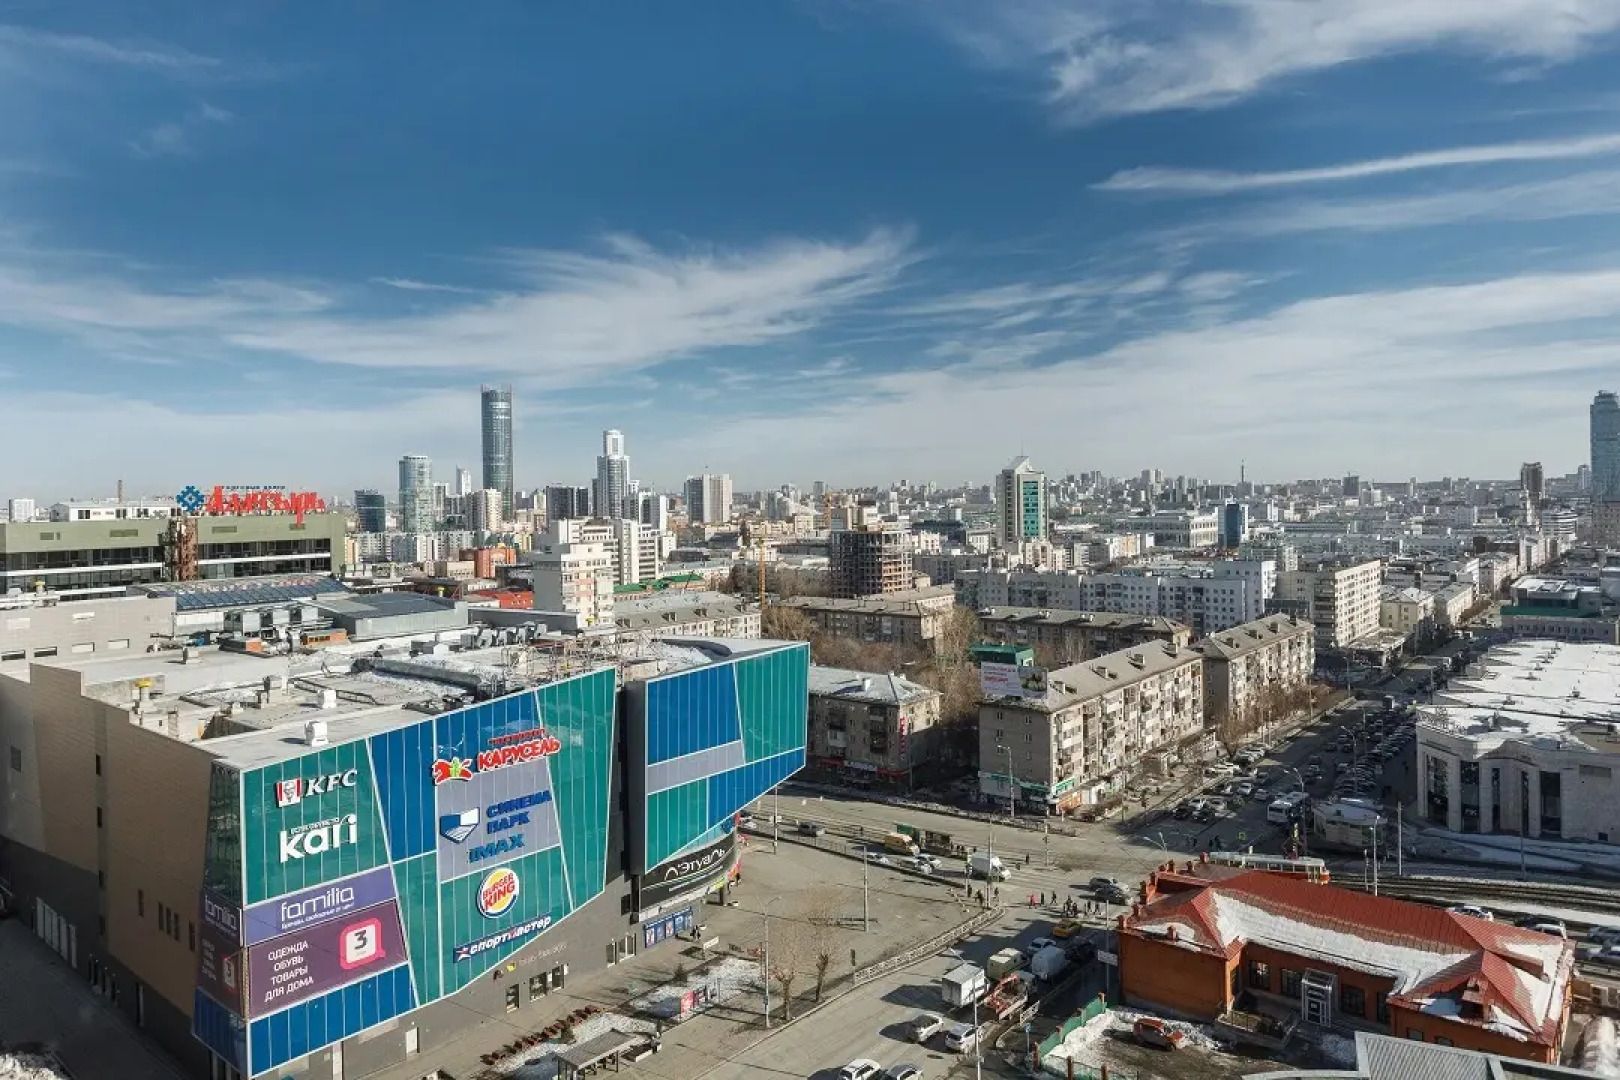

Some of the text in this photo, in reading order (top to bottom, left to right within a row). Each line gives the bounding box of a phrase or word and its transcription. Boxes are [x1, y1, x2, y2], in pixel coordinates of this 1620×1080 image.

[477, 736, 561, 772] КАРУСЕЛЬ
[305, 769, 358, 797] KFC
[486, 790, 552, 818] СИНЕМА
[486, 811, 530, 834] ПАРК
[280, 813, 357, 863] kari
[469, 834, 525, 864] IMAX
[482, 872, 515, 901] BURGER
[484, 883, 516, 911] KING
[281, 887, 355, 922] familia
[268, 940, 309, 961] ОДЕЖДА
[354, 929, 368, 950] 3
[271, 966, 308, 986] ТОВАРЫ
[273, 956, 304, 972] ОБУВЬ
[264, 976, 315, 1003] ДЛЯ ДОМА
